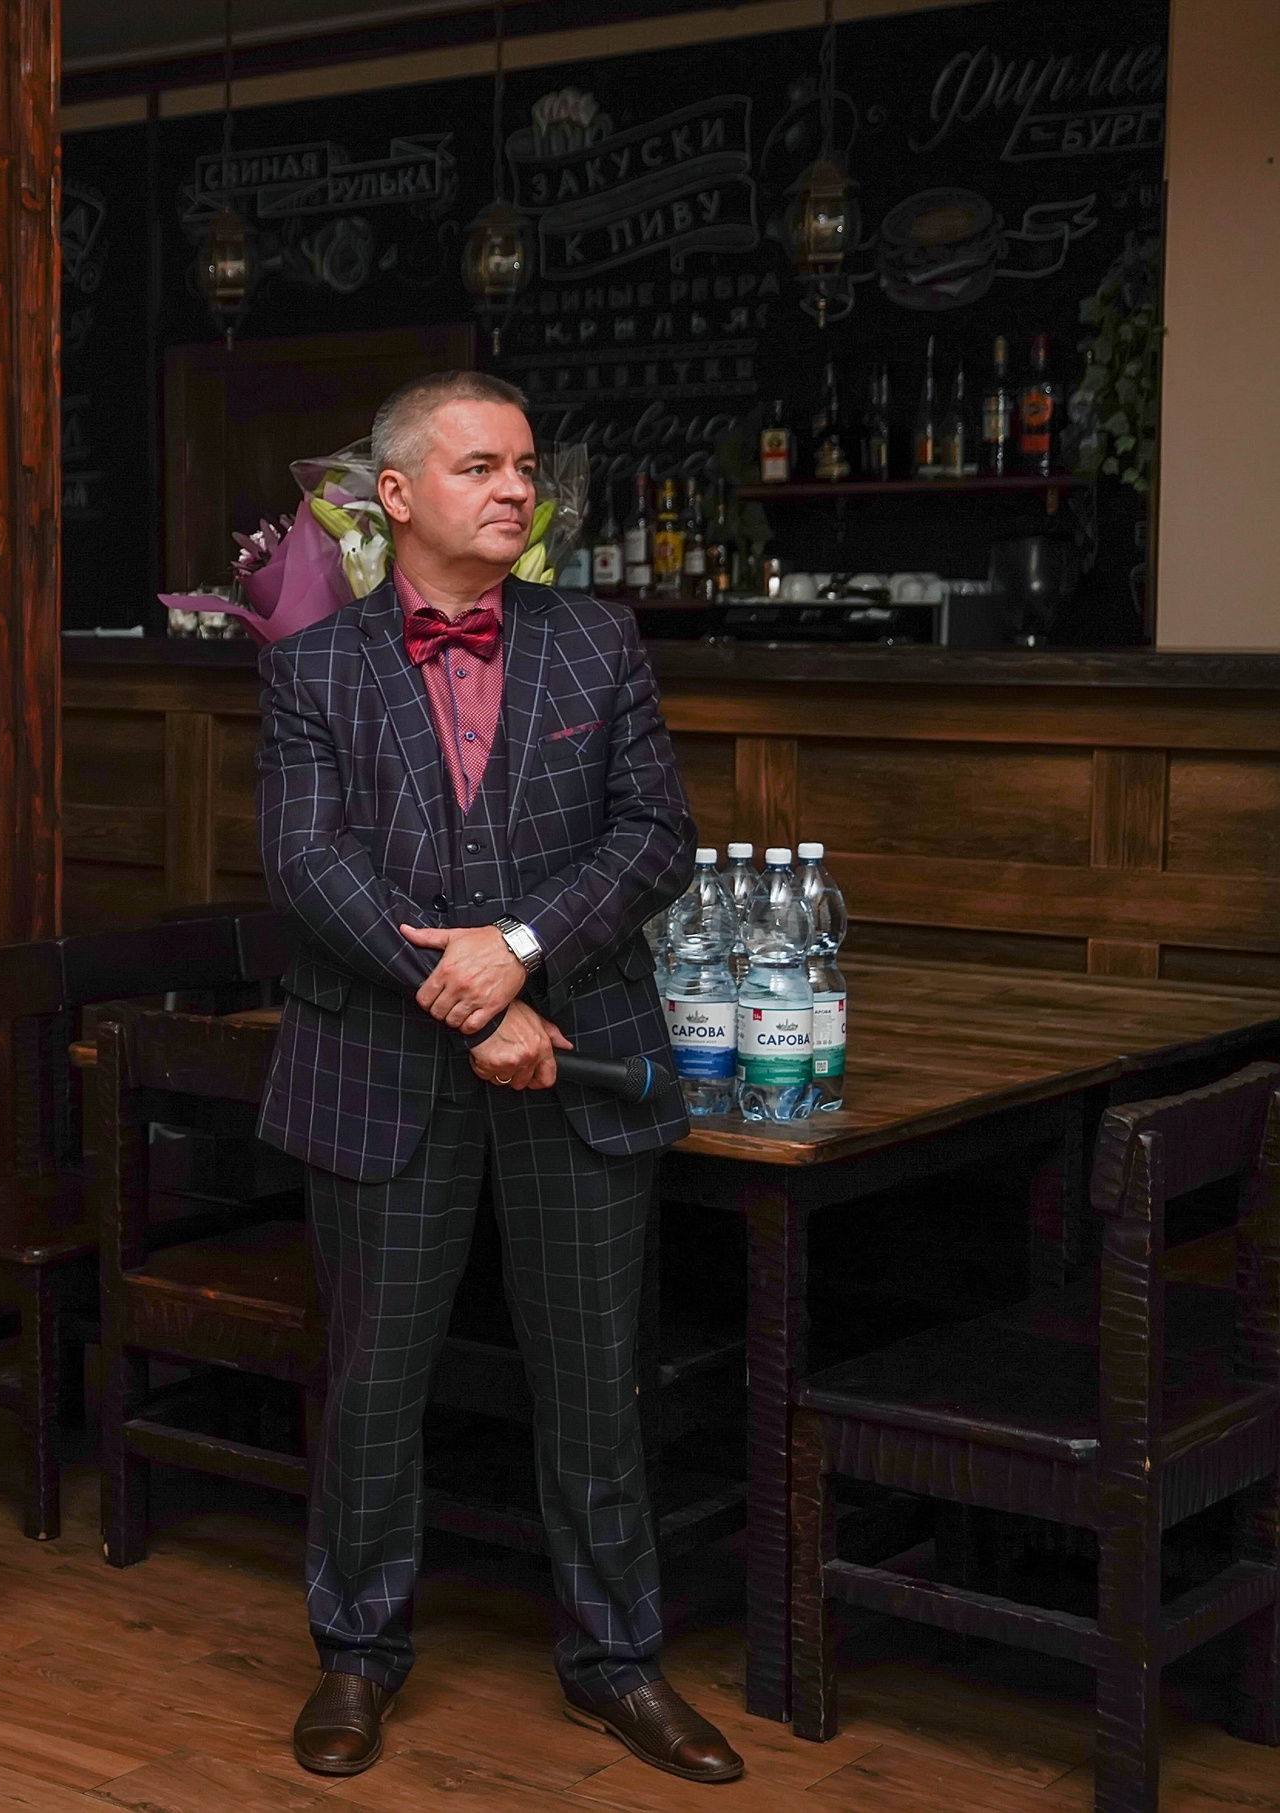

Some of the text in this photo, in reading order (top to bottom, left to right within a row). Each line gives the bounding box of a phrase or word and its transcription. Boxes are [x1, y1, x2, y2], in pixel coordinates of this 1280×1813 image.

[1061, 111, 1163, 151] БУРГ
[205, 151, 319, 190] СВИНАЯ
[531, 118, 725, 201] ЗАКУСКИ
[328, 163, 436, 200] РУЛЬКА
[565, 188, 720, 265] К ПИВУ
[671, 1024, 725, 1038] САРОВА
[757, 1033, 810, 1046] САРОВА
